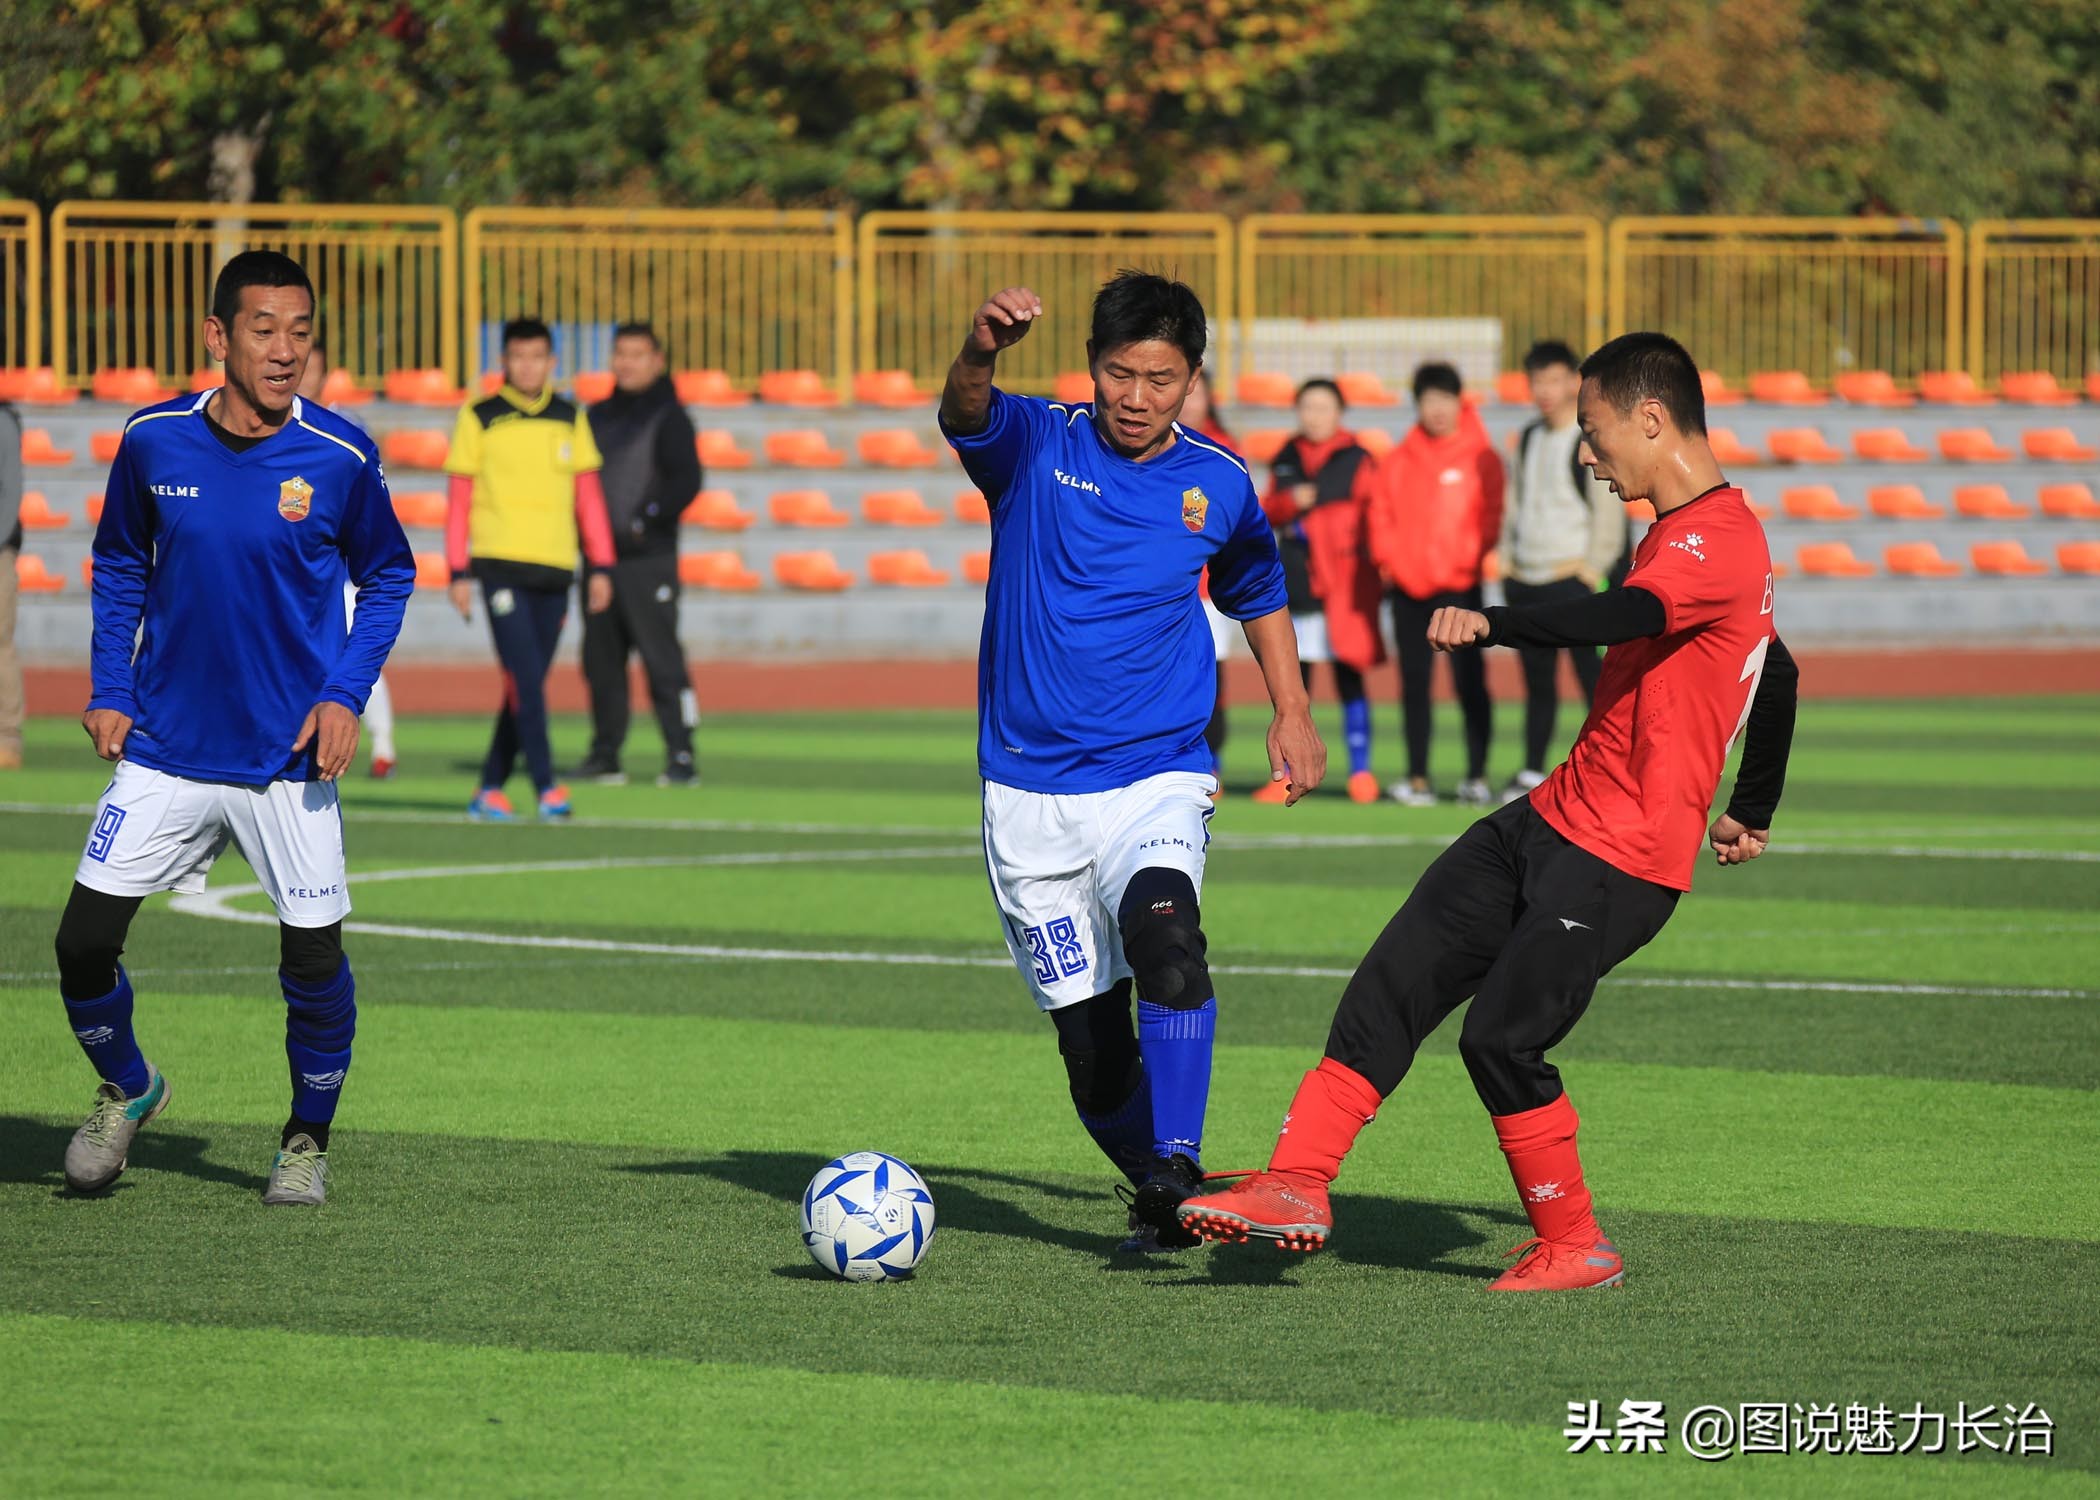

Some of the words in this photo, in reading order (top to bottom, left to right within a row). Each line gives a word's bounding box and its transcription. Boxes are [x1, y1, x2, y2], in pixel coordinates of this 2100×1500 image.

[150, 485, 199, 497] KELME
[1055, 468, 1101, 497] KELME
[1669, 540, 1706, 562] KELME
[87, 803, 127, 863] 9
[1139, 838, 1193, 852] KELME
[288, 884, 338, 898] KELME
[1024, 915, 1089, 985] 38
